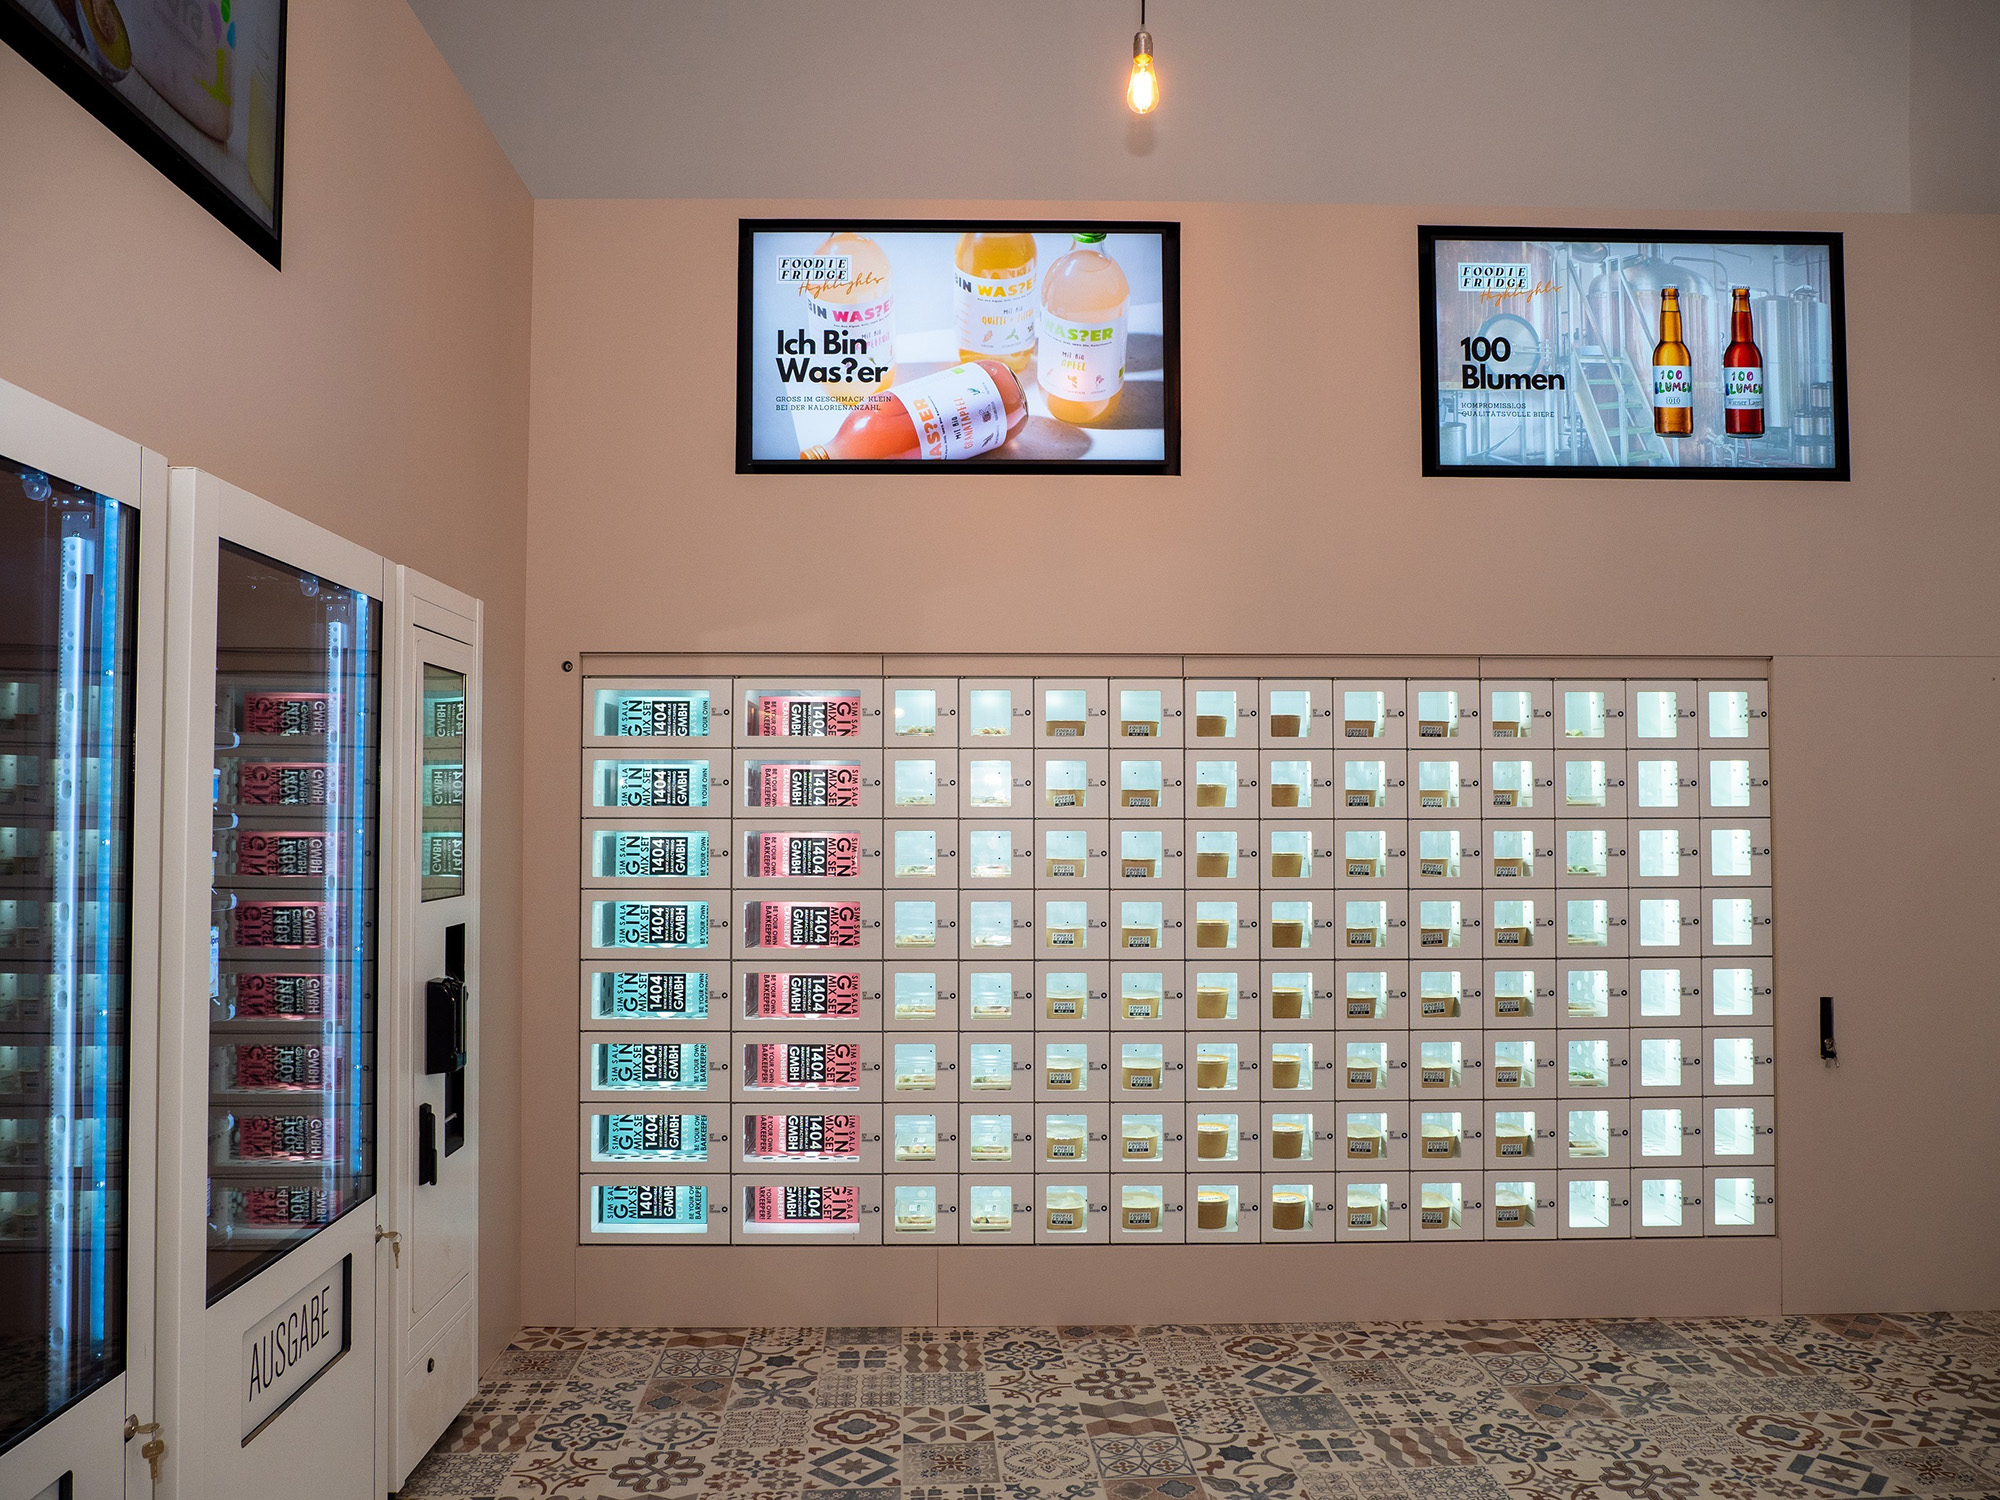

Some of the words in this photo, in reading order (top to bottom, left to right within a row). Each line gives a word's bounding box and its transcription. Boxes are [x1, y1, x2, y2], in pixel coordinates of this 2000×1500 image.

[782, 259, 846, 268] FOODIE
[782, 270, 846, 280] FRIDGE
[1463, 267, 1526, 277] FOODIE
[798, 272, 885, 299] Highlights
[1463, 278, 1526, 288] FRIDGE
[1480, 280, 1563, 308] Highlights
[778, 328, 816, 355] Ich
[824, 330, 866, 354] Bin
[1460, 336, 1511, 362] 100
[776, 358, 888, 383] Was?er
[1462, 364, 1565, 390] Blumen
[1660, 369, 1682, 380] 100
[1732, 371, 1754, 381] 100
[914, 398, 942, 460] AS?ER
[628, 700, 642, 736] GIN
[643, 701, 651, 716] SET
[828, 703, 836, 721] MIX
[837, 702, 851, 736] GIN
[628, 768, 642, 806] GIN
[654, 771, 666, 804] 1404
[677, 771, 688, 804] GMBH
[792, 771, 802, 805] GMBH
[813, 772, 825, 805] 1404
[829, 770, 837, 789] MIX
[838, 770, 852, 806] GIN
[626, 836, 640, 875] GIN
[652, 839, 664, 872] 1404
[676, 839, 685, 873] GMBH
[791, 840, 801, 873] GMBH
[813, 840, 825, 874] 1404
[828, 838, 836, 857] MIX
[837, 838, 851, 876] GIN
[828, 861, 836, 876] SET
[626, 905, 640, 943] GIN
[652, 908, 664, 941] 1404
[675, 908, 685, 941] GMBH
[793, 909, 803, 942] GMBH
[815, 910, 827, 943] 1404
[830, 907, 839, 926] MIX
[839, 907, 854, 946] GIN
[830, 930, 839, 946] SET
[624, 973, 638, 1012] GIN
[650, 976, 662, 1009] 1404
[674, 976, 684, 1009] GMBH
[791, 978, 801, 1011] GMBH
[813, 978, 825, 1011] 1404
[829, 976, 837, 995] MIX
[837, 976, 851, 1014] GIN
[829, 999, 837, 1014] SET
[618, 1044, 632, 1081] GIN
[645, 1045, 657, 1078] 1404
[669, 1045, 679, 1079] GMBH
[790, 1046, 800, 1080] GMBH
[811, 1047, 823, 1080] 1404
[827, 1044, 835, 1064] MIX
[836, 1044, 850, 1083] GIN
[633, 1062, 641, 1081] MIX
[827, 1067, 835, 1082] SET
[619, 1115, 633, 1150] GIN
[634, 1131, 642, 1150] MIX
[645, 1115, 657, 1147] 1404
[669, 1115, 679, 1148] GMBH
[788, 1116, 798, 1150] GMBH
[810, 1116, 822, 1150] 1404
[826, 1115, 834, 1134] MIX
[835, 1115, 849, 1152] GIN
[826, 1137, 834, 1152] SET
[824, 1204, 832, 1219] SET
[249, 1286, 330, 1402] AUSGABE
